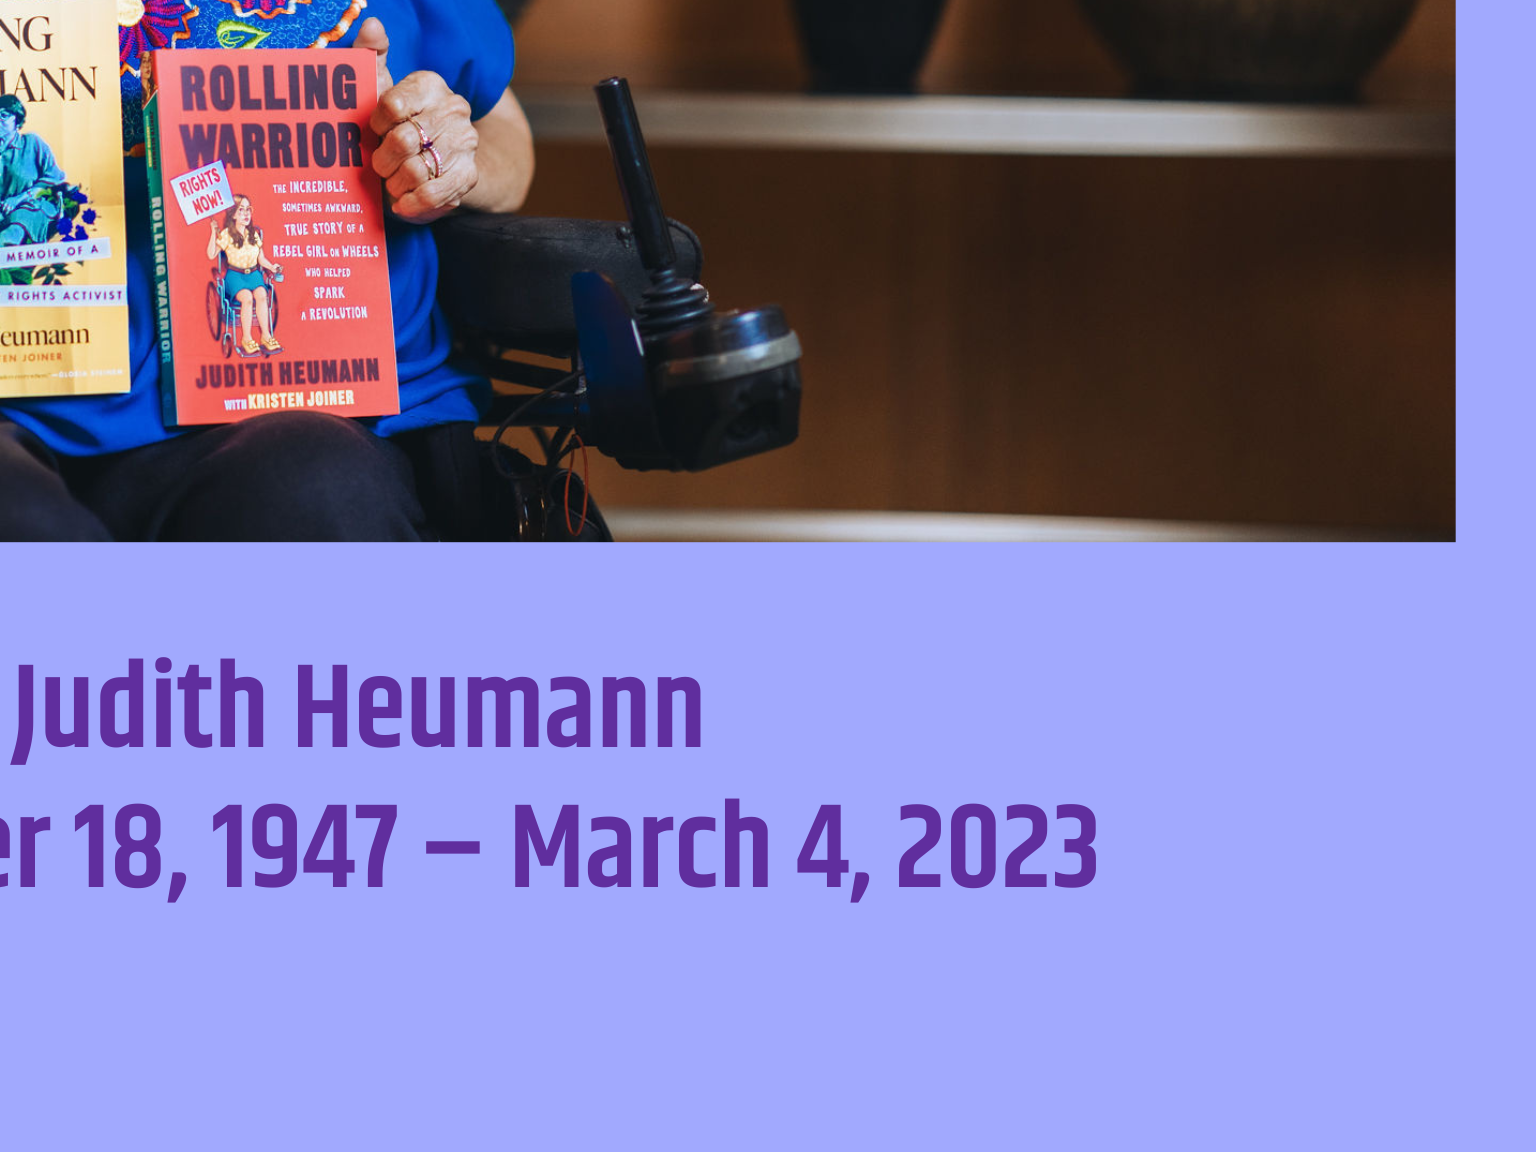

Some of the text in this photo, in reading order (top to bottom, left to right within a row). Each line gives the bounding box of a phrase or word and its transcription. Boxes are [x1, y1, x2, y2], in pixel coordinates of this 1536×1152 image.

[180, 63, 358, 111] ROLLING
[178, 121, 363, 169] WARRIOR
[178, 168, 221, 198] RIGHTS
[273, 181, 348, 194] THE INCREDIBLE,
[192, 191, 224, 216] NOW!
[282, 202, 363, 213] SOMETIMES AWKWARD,
[150, 196, 166, 276] ROLLING
[284, 223, 308, 236] TRUE
[313, 222, 343, 236] STORY
[347, 224, 355, 233] OF
[6, 248, 60, 262] MEMOIR
[67, 246, 84, 256] OF
[91, 244, 99, 254] A
[273, 244, 379, 258] REBEL GIRL ON WHEELS
[305, 268, 351, 278] WHO HELPED
[8, 291, 56, 301] RIGHTS
[62, 291, 122, 300] ACTIVIST
[314, 285, 345, 299] SPARK
[301, 307, 368, 321] A REVOLUTION
[157, 280, 171, 365] WARRIOR
[22, 353, 62, 362] JOINER
[196, 358, 380, 390] JUDITH HEUMANN
[224, 390, 354, 410] WITH KRISTEN JOINER
